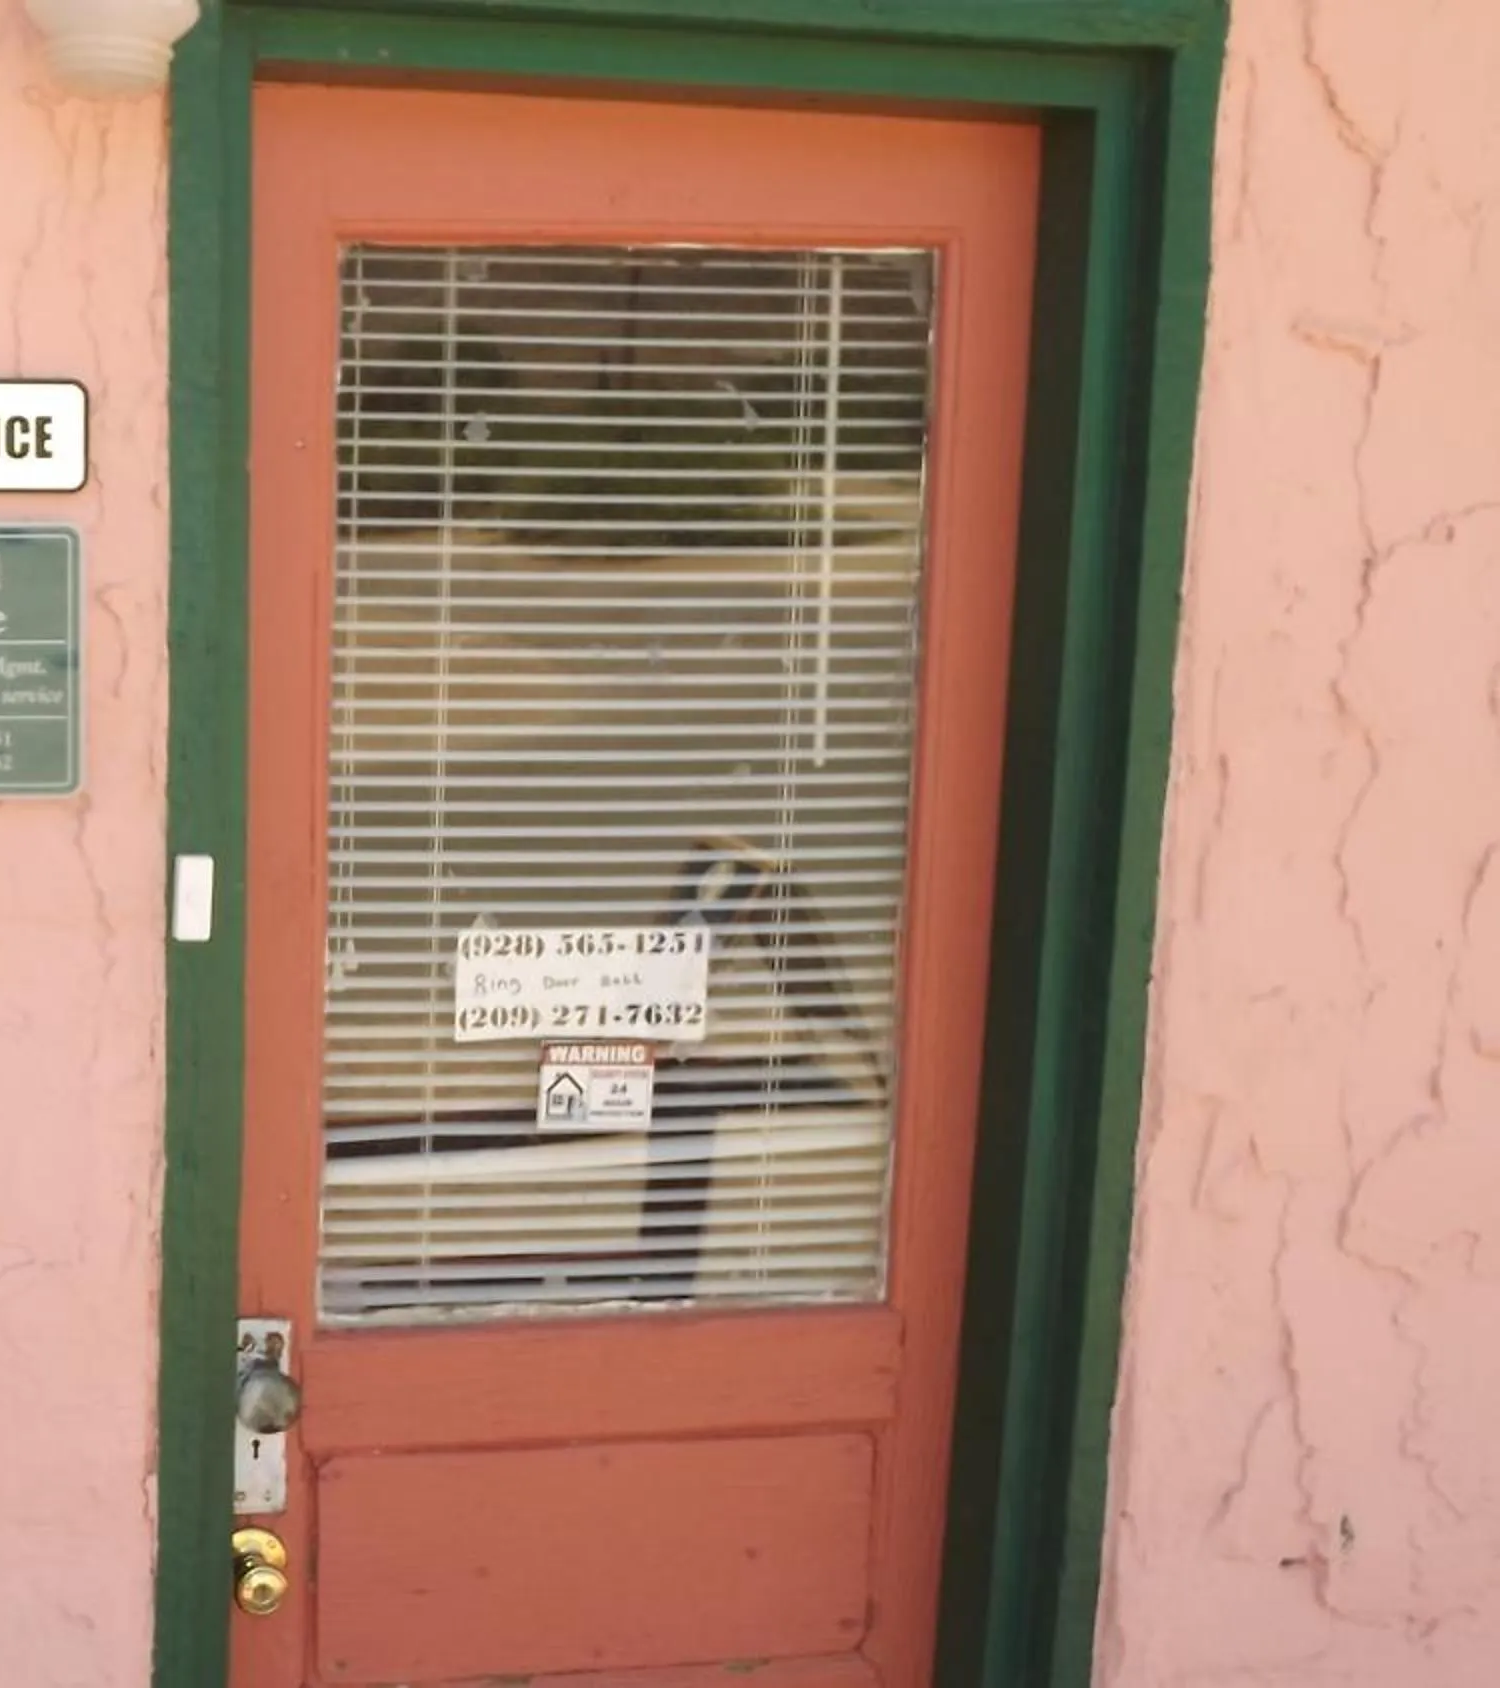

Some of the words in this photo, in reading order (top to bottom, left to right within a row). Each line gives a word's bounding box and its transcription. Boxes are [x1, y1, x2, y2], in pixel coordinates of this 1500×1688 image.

[2, 686, 64, 704] service
[460, 933, 545, 959] (928)
[473, 973, 523, 996] Ring
[458, 1004, 541, 1031] (209)
[551, 1004, 702, 1027] 271-7632
[548, 1045, 646, 1063] WARNING
